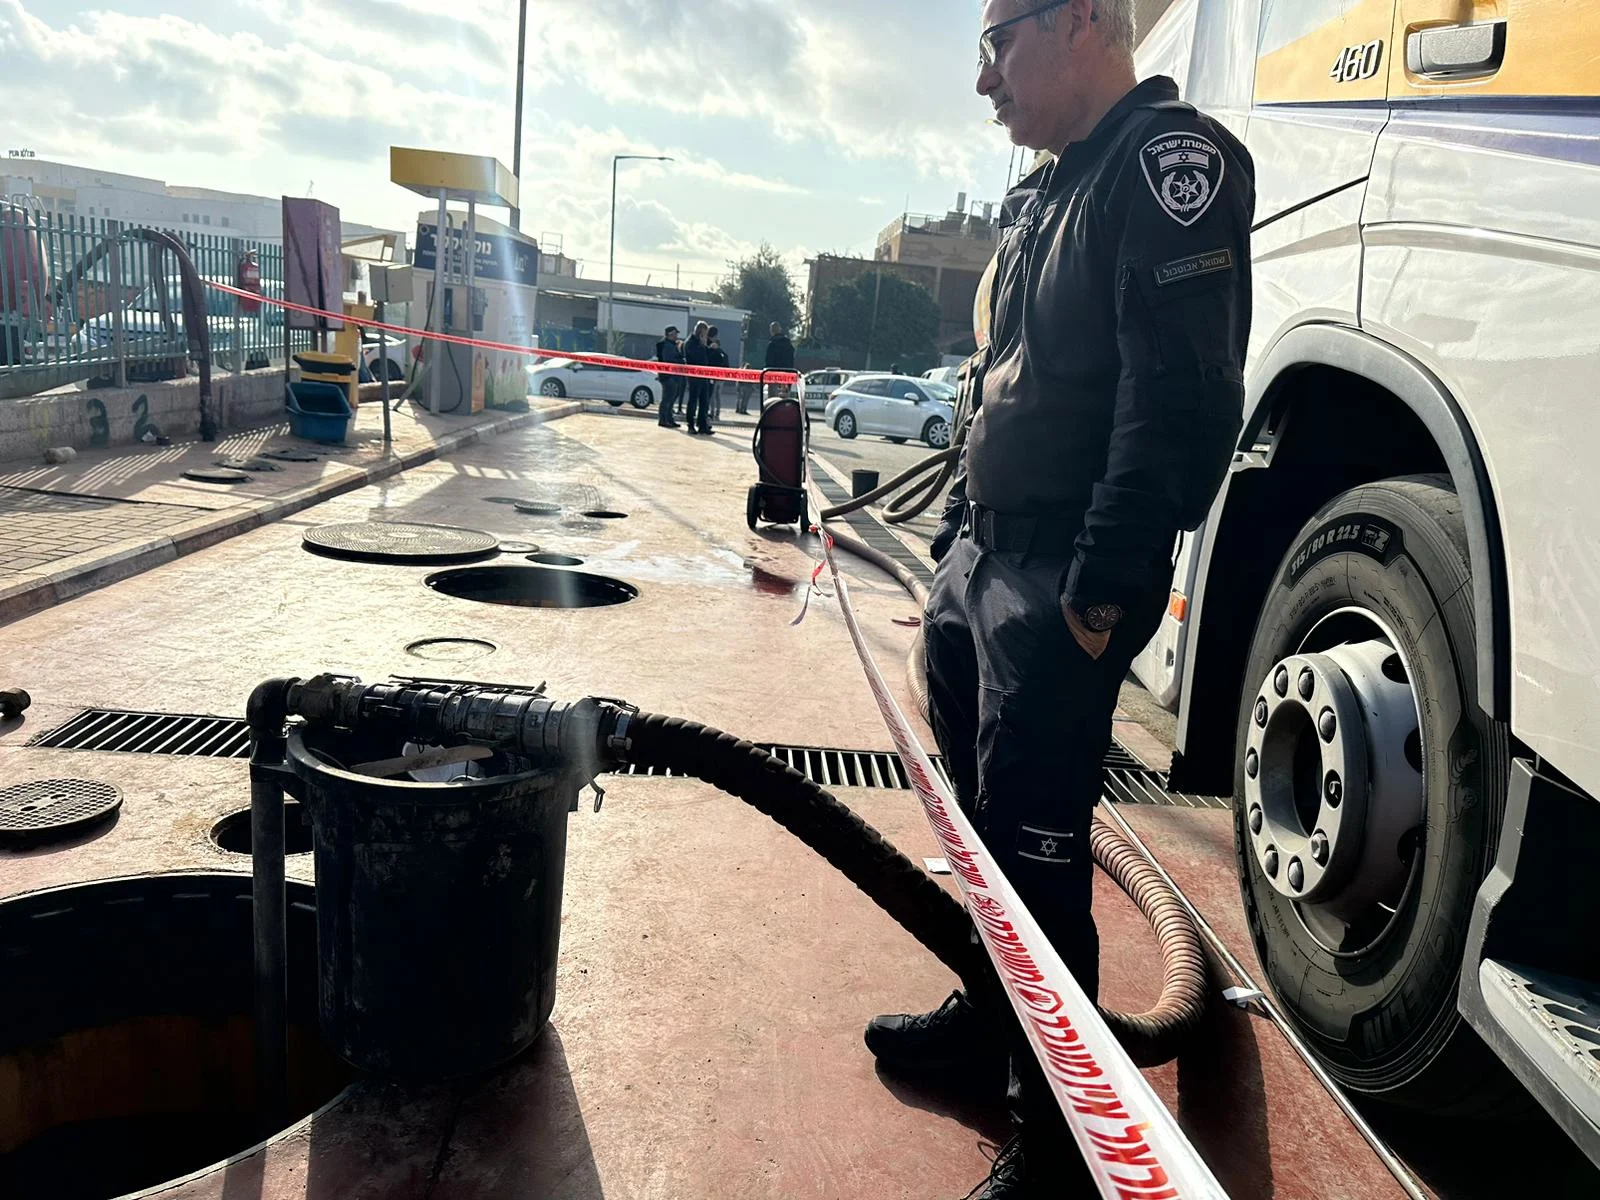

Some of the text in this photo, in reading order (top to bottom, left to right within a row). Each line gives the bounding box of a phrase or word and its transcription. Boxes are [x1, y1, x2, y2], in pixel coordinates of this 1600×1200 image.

[1329, 39, 1384, 83] 460
[1147, 139, 1217, 155] משטרת ישראל
[1163, 255, 1226, 277] שמואל אבוטבול
[1326, 529, 1336, 545] R
[972, 904, 1045, 982] משטרת
[1029, 1014, 1104, 1080] מעבר
[1050, 1066, 1130, 1119] אין
